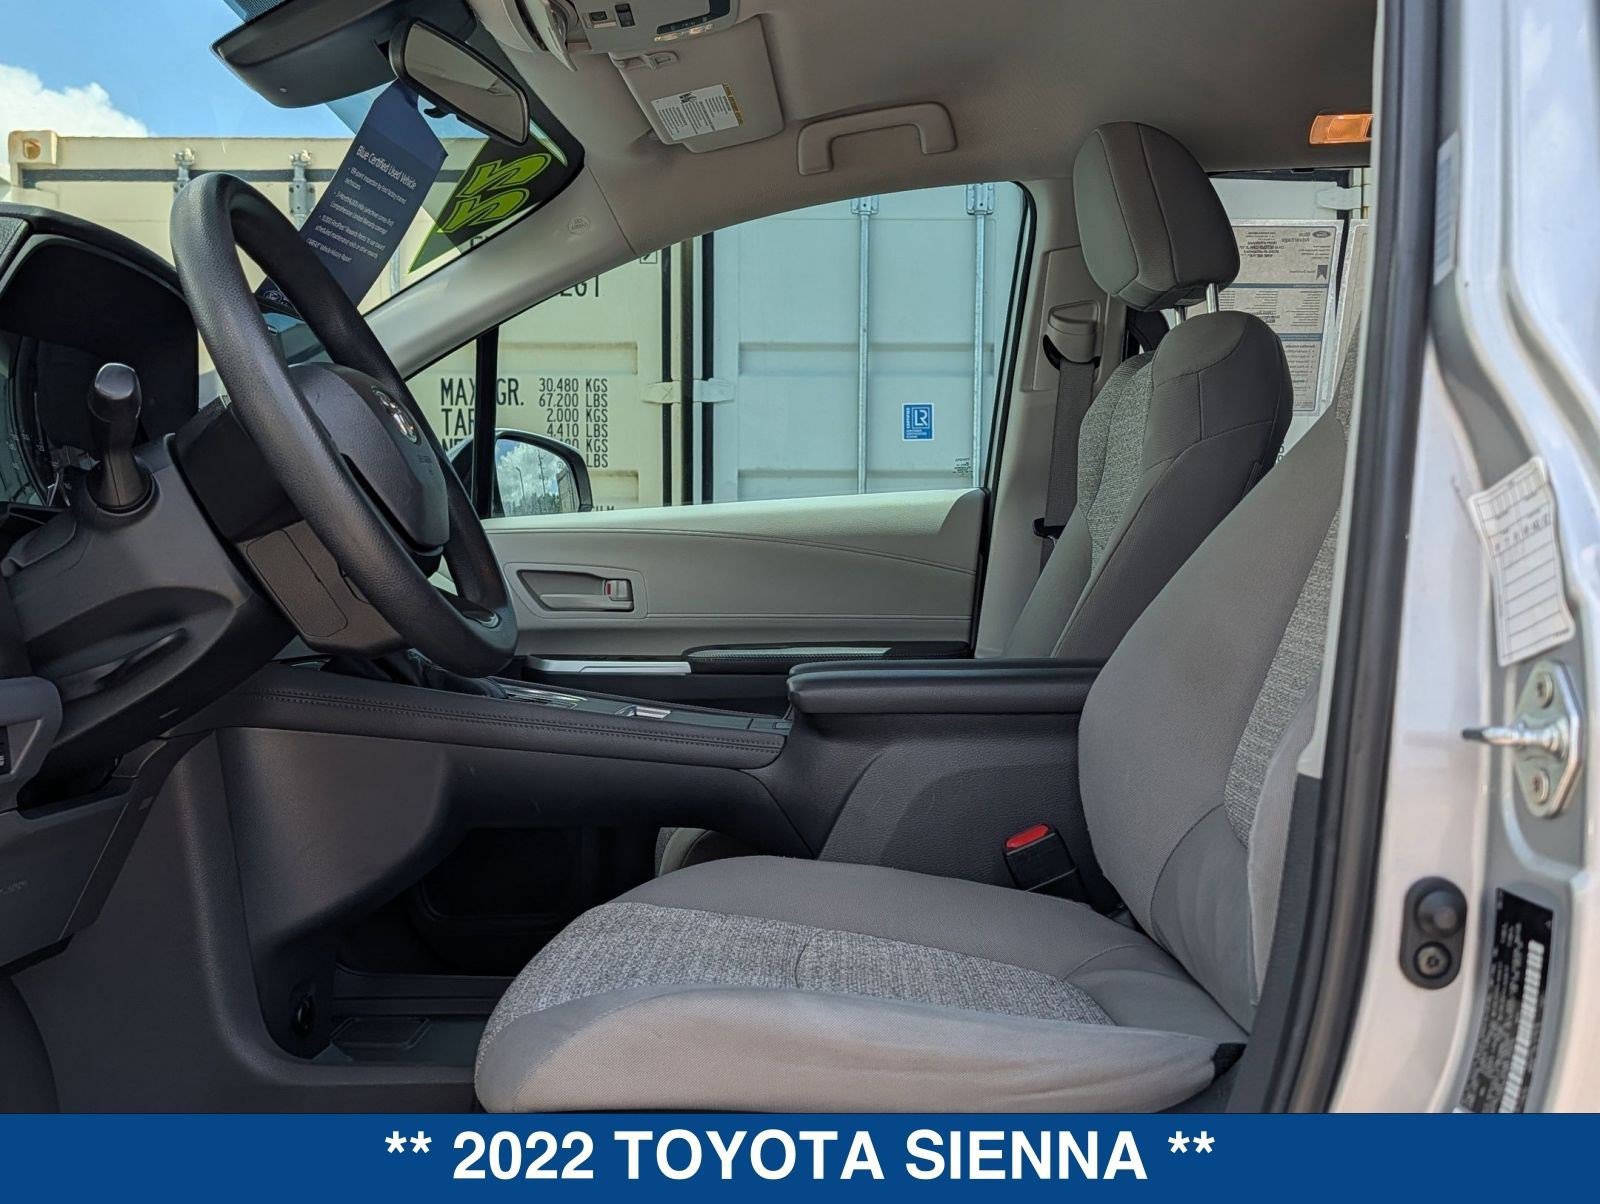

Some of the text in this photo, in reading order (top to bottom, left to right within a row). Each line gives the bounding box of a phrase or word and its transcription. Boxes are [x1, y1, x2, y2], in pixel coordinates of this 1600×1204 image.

[356, 145, 370, 160] Blue
[388, 165, 402, 180] Used
[496, 378, 524, 406] GR.
[586, 378, 608, 392] KGS
[586, 393, 608, 407] LBS
[441, 408, 475, 436] TAR
[586, 408, 608, 422] KGS
[586, 423, 608, 438] LBS
[586, 439, 608, 453] KGS
[586, 454, 608, 468] LBS
